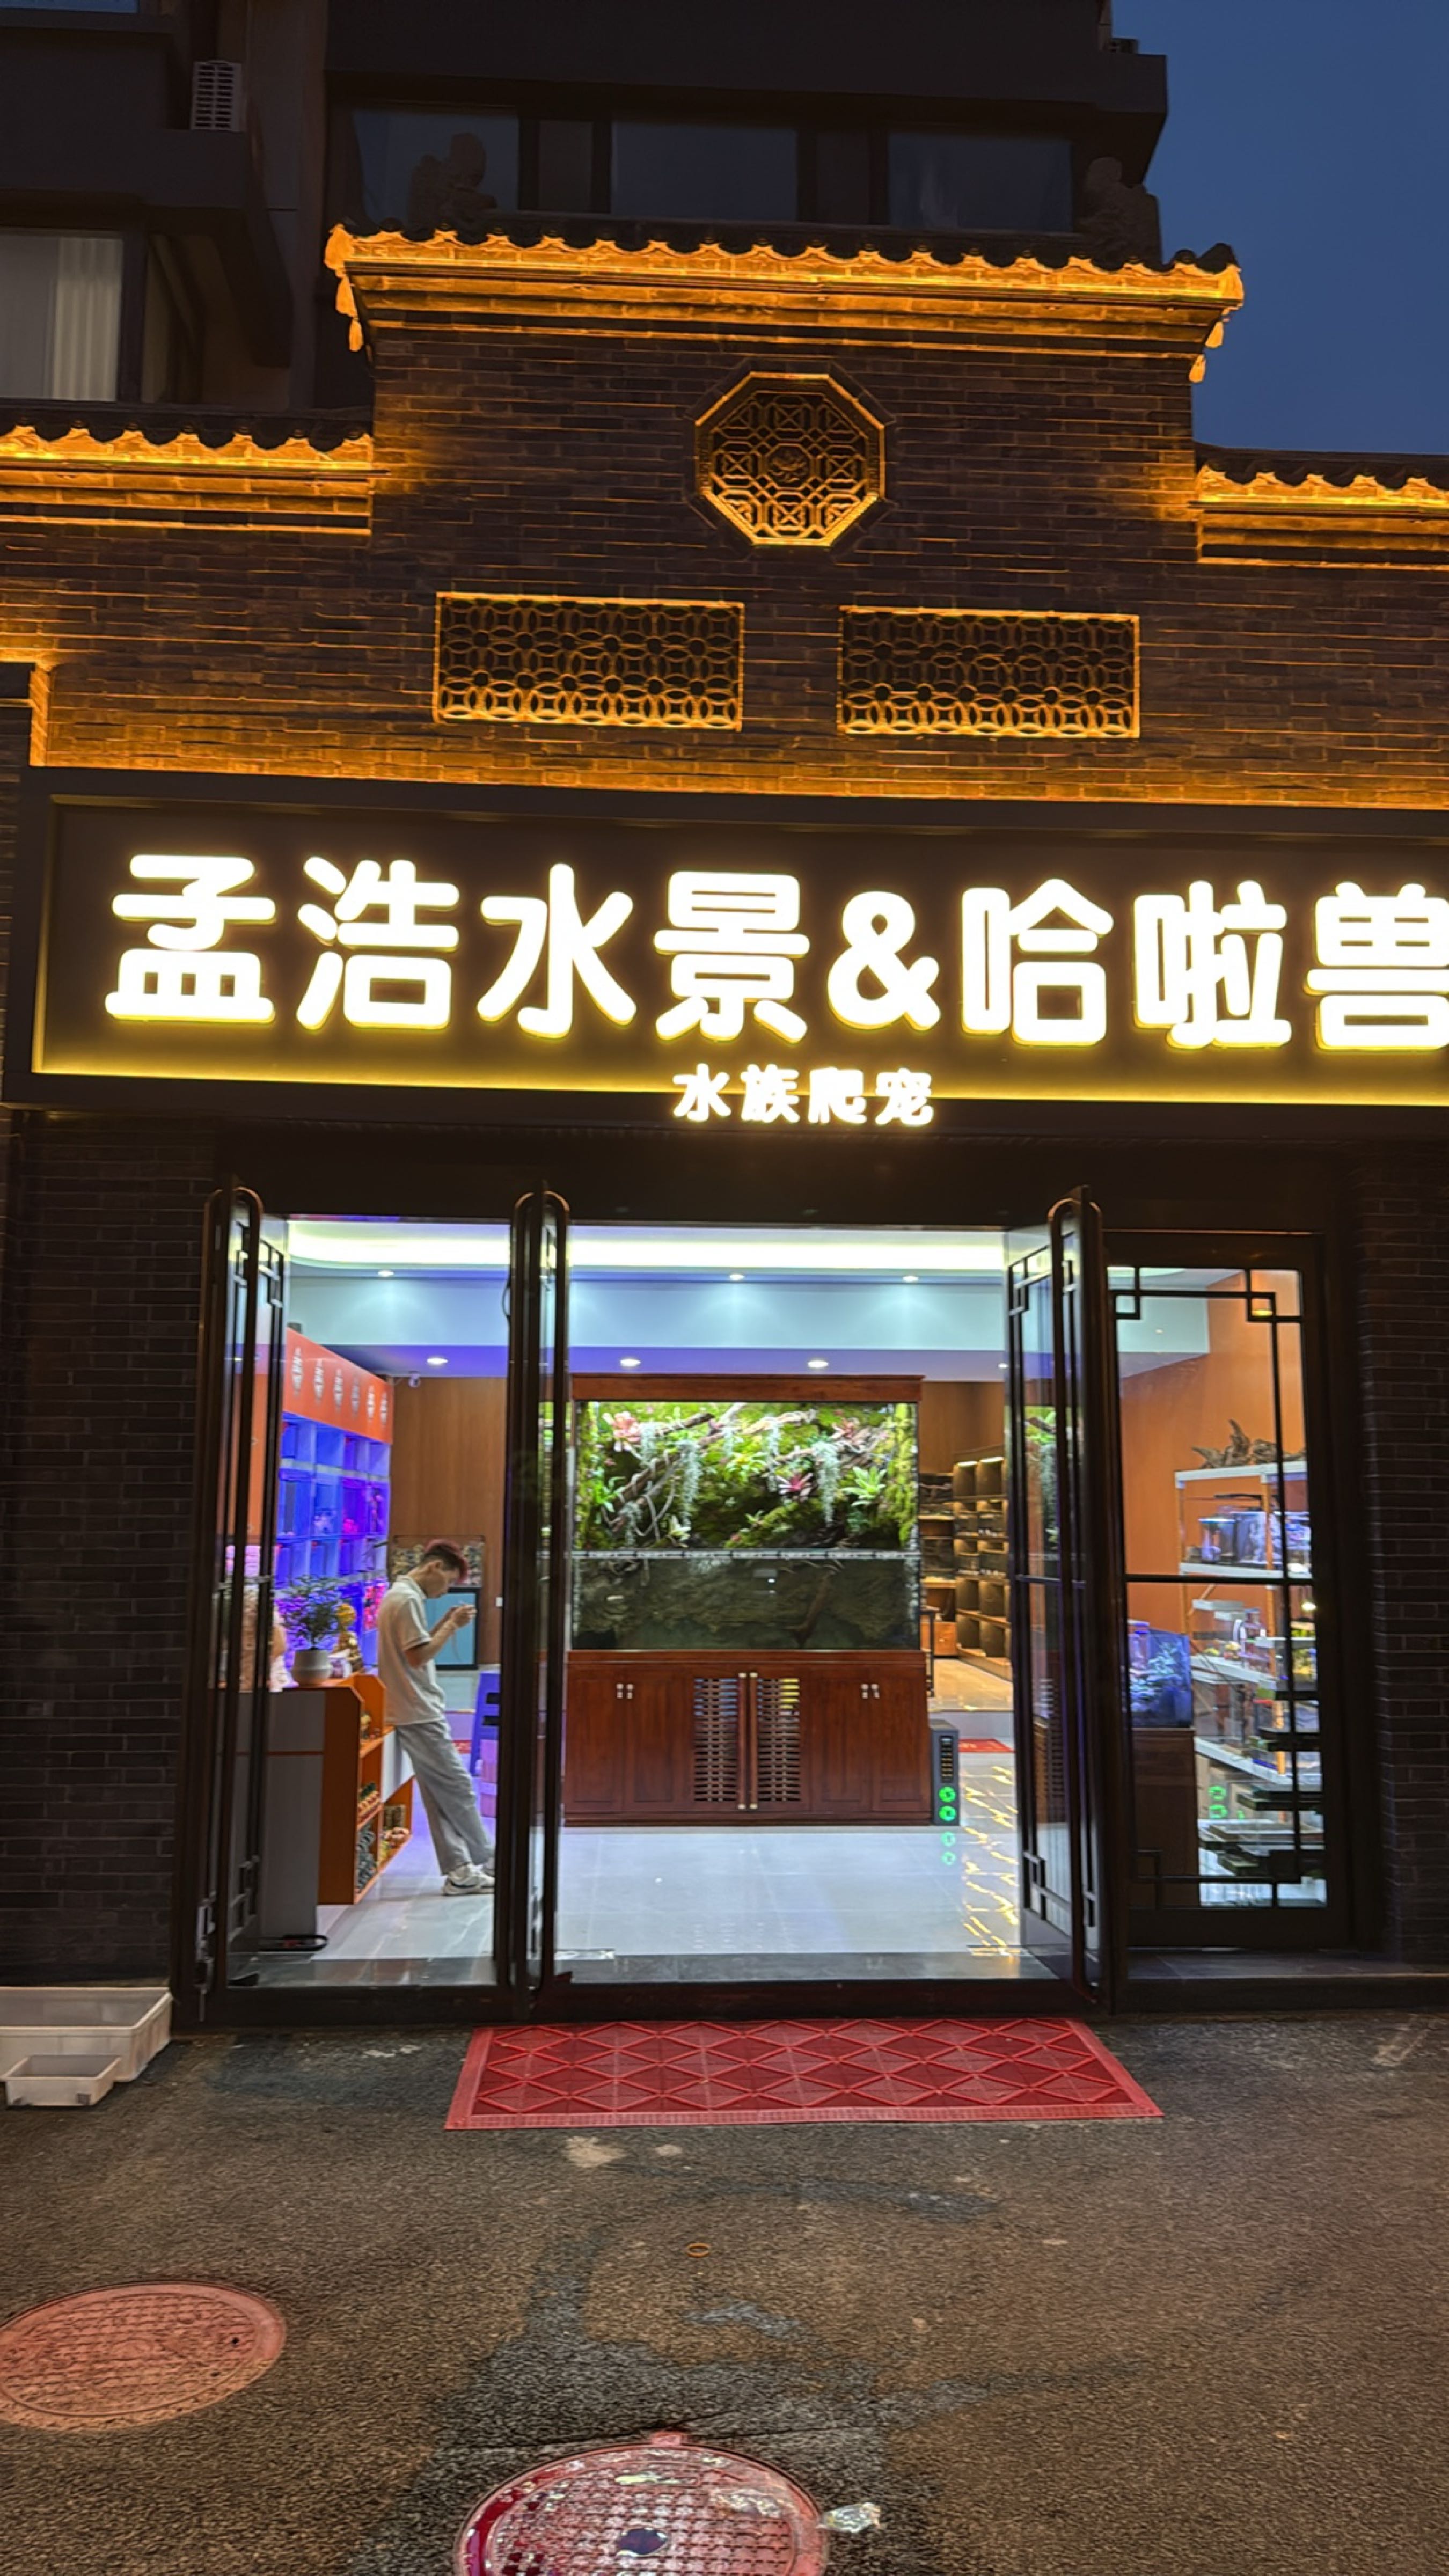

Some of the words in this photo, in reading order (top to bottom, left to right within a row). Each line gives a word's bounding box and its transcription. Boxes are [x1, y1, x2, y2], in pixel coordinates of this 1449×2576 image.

[104, 853, 1449, 1050] 孟浩水景&哈啦兽
[672, 1063, 934, 1127] 水族爬宠
